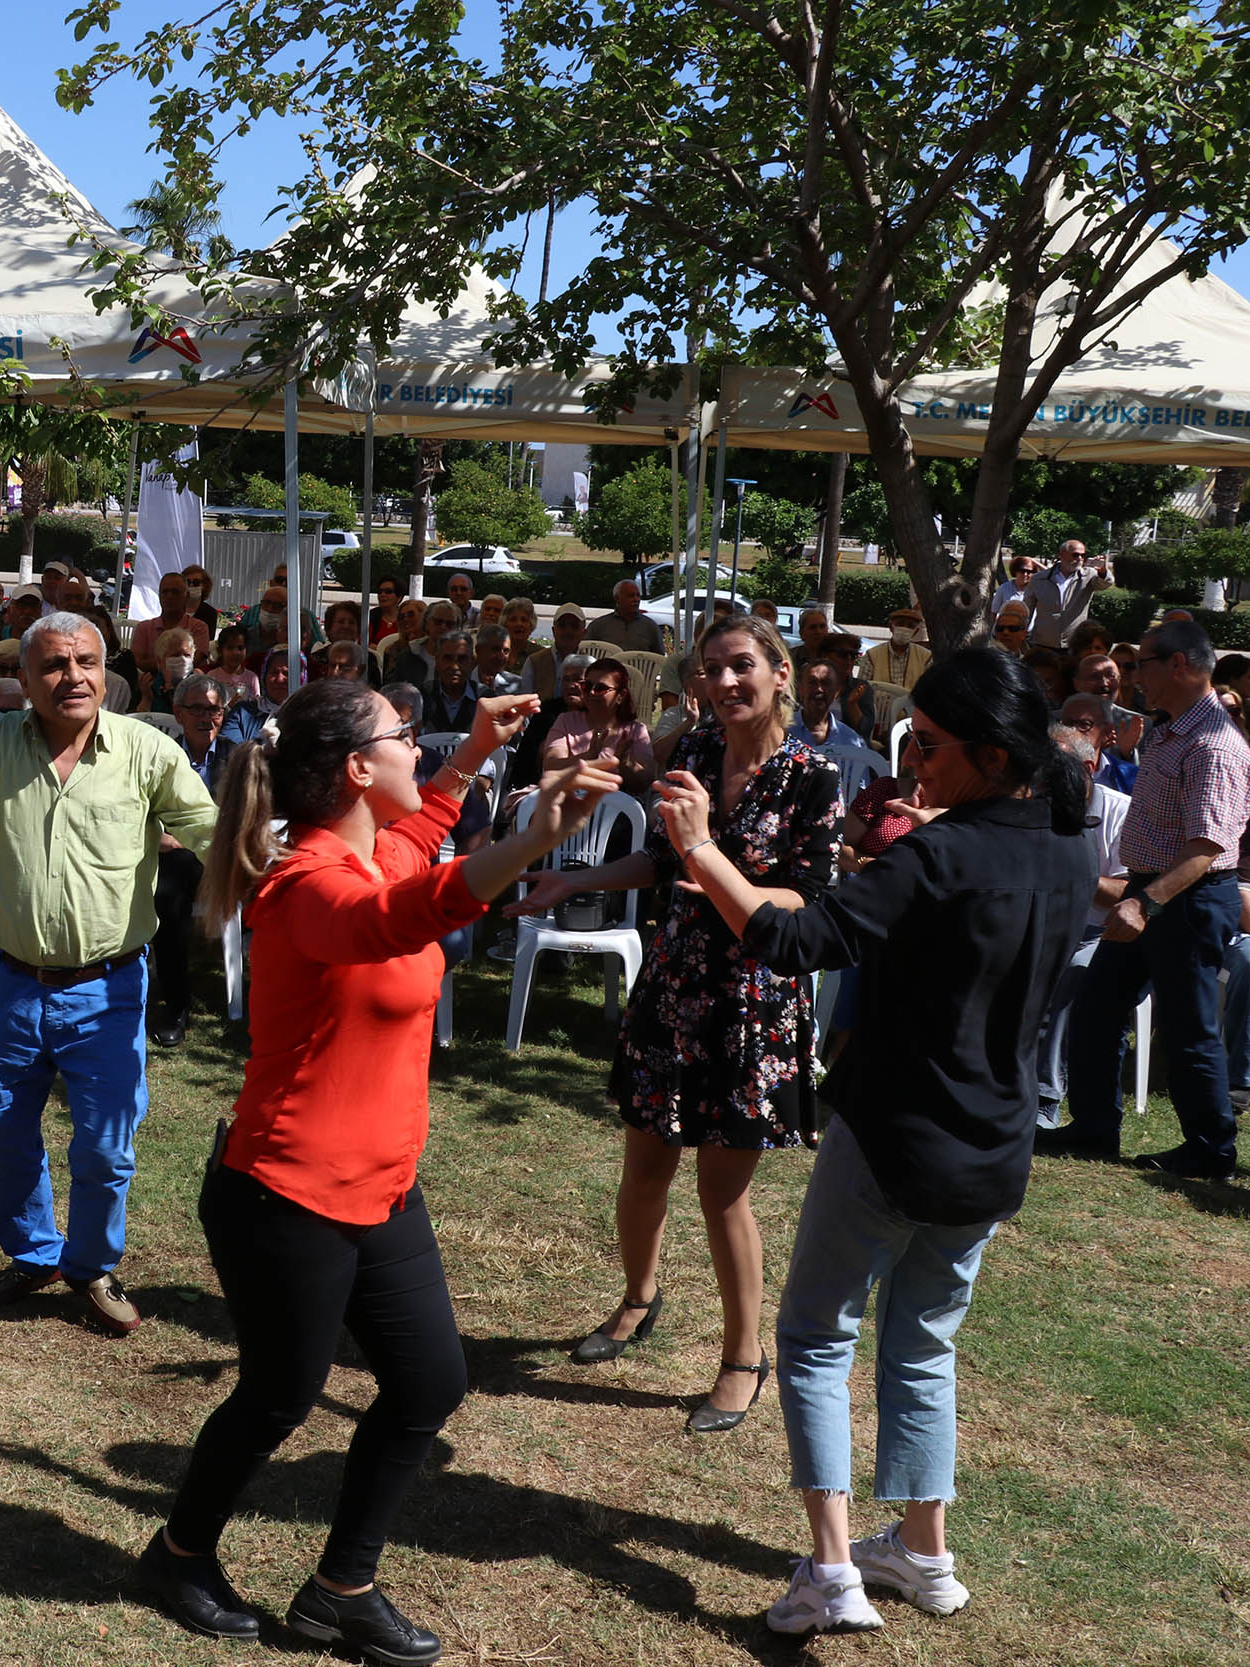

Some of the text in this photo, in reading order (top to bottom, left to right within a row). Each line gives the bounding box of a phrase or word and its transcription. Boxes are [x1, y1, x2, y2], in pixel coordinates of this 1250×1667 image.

[401, 383, 513, 405] BELEDİYESİ
[912, 401, 950, 419] T.C.
[1054, 399, 1206, 429] BÜYÜKŞEHİR
